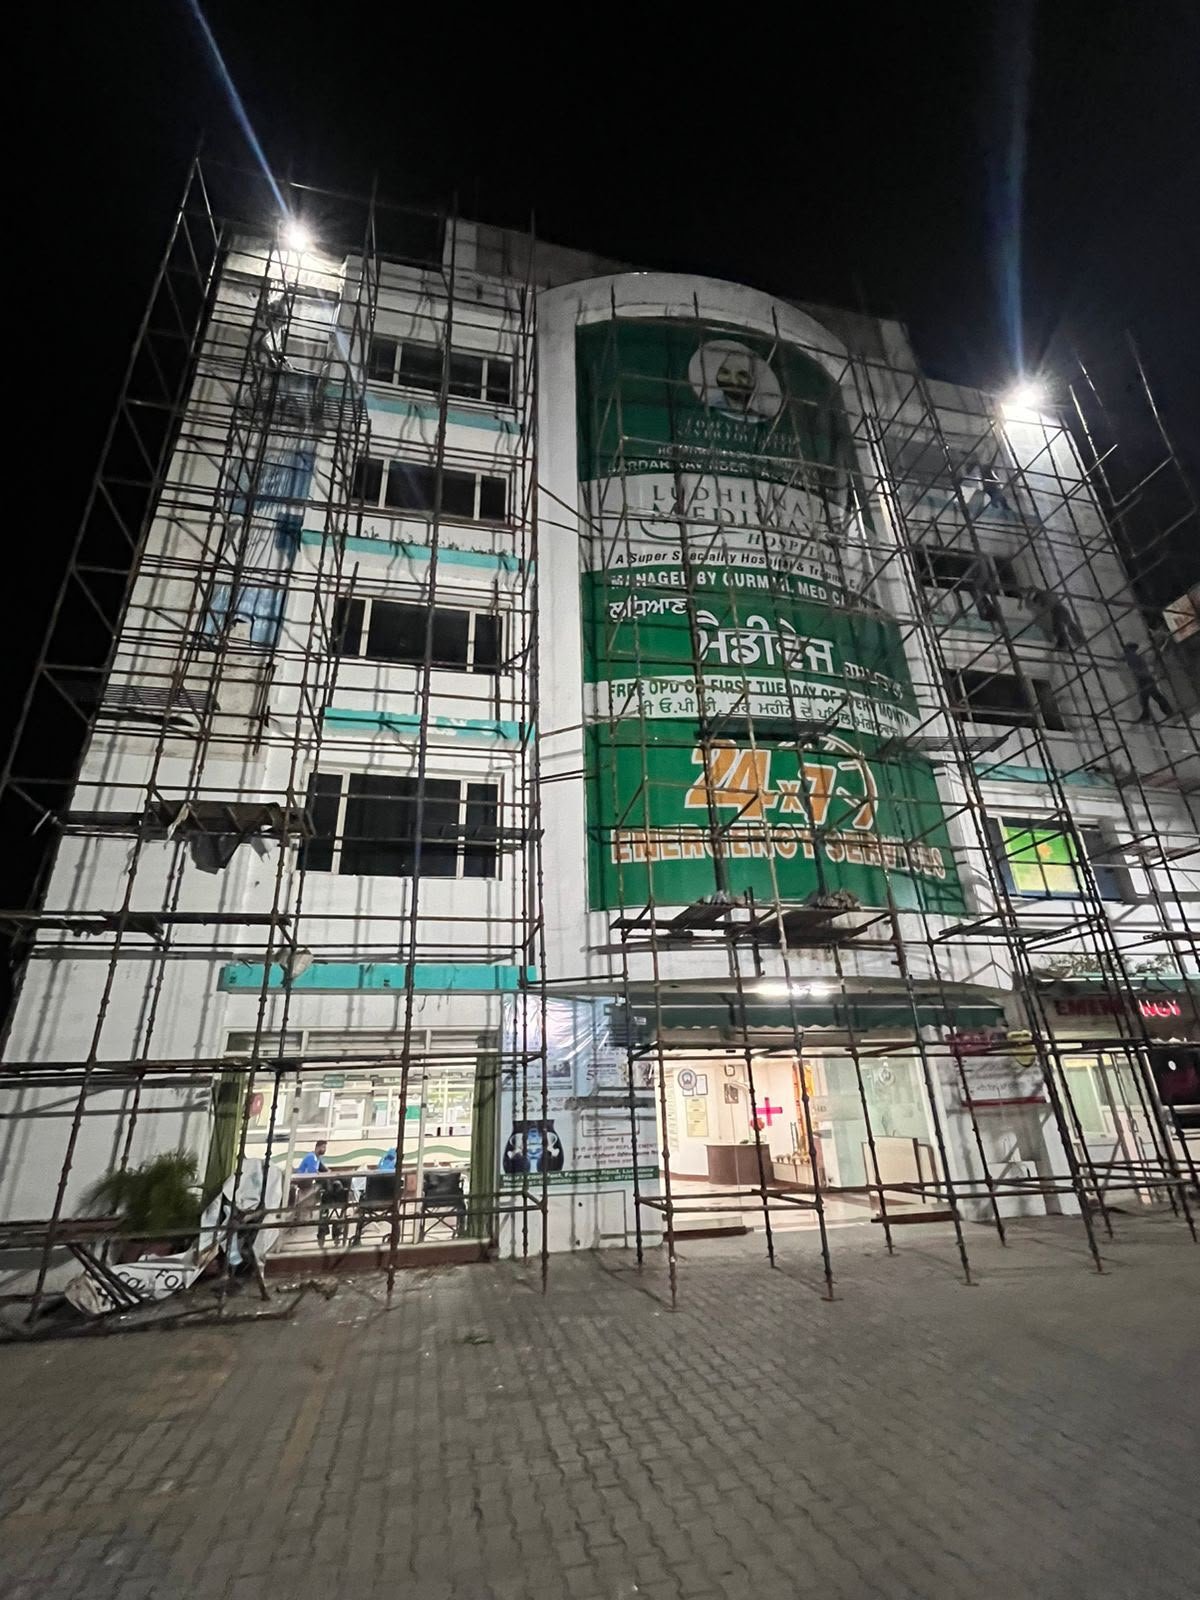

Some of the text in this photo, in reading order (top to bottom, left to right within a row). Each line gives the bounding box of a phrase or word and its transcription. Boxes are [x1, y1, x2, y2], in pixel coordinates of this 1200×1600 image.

[616, 555, 624, 564] A
[630, 553, 668, 565] Super
[672, 550, 735, 564] Secialiy
[741, 554, 793, 571] Hosital
[797, 562, 804, 572] &
[697, 571, 716, 585] BY
[798, 581, 827, 601] MED
[609, 594, 690, 622] ਲੁਧਿਆਣ
[609, 682, 645, 697] FREE
[648, 682, 679, 695] OPD
[684, 681, 702, 694] O
[711, 679, 752, 694] FIRST
[757, 680, 817, 701] TUEDAY
[821, 688, 836, 704] OF
[878, 702, 911, 728] MONTH
[610, 824, 816, 863] EMERGENCY
